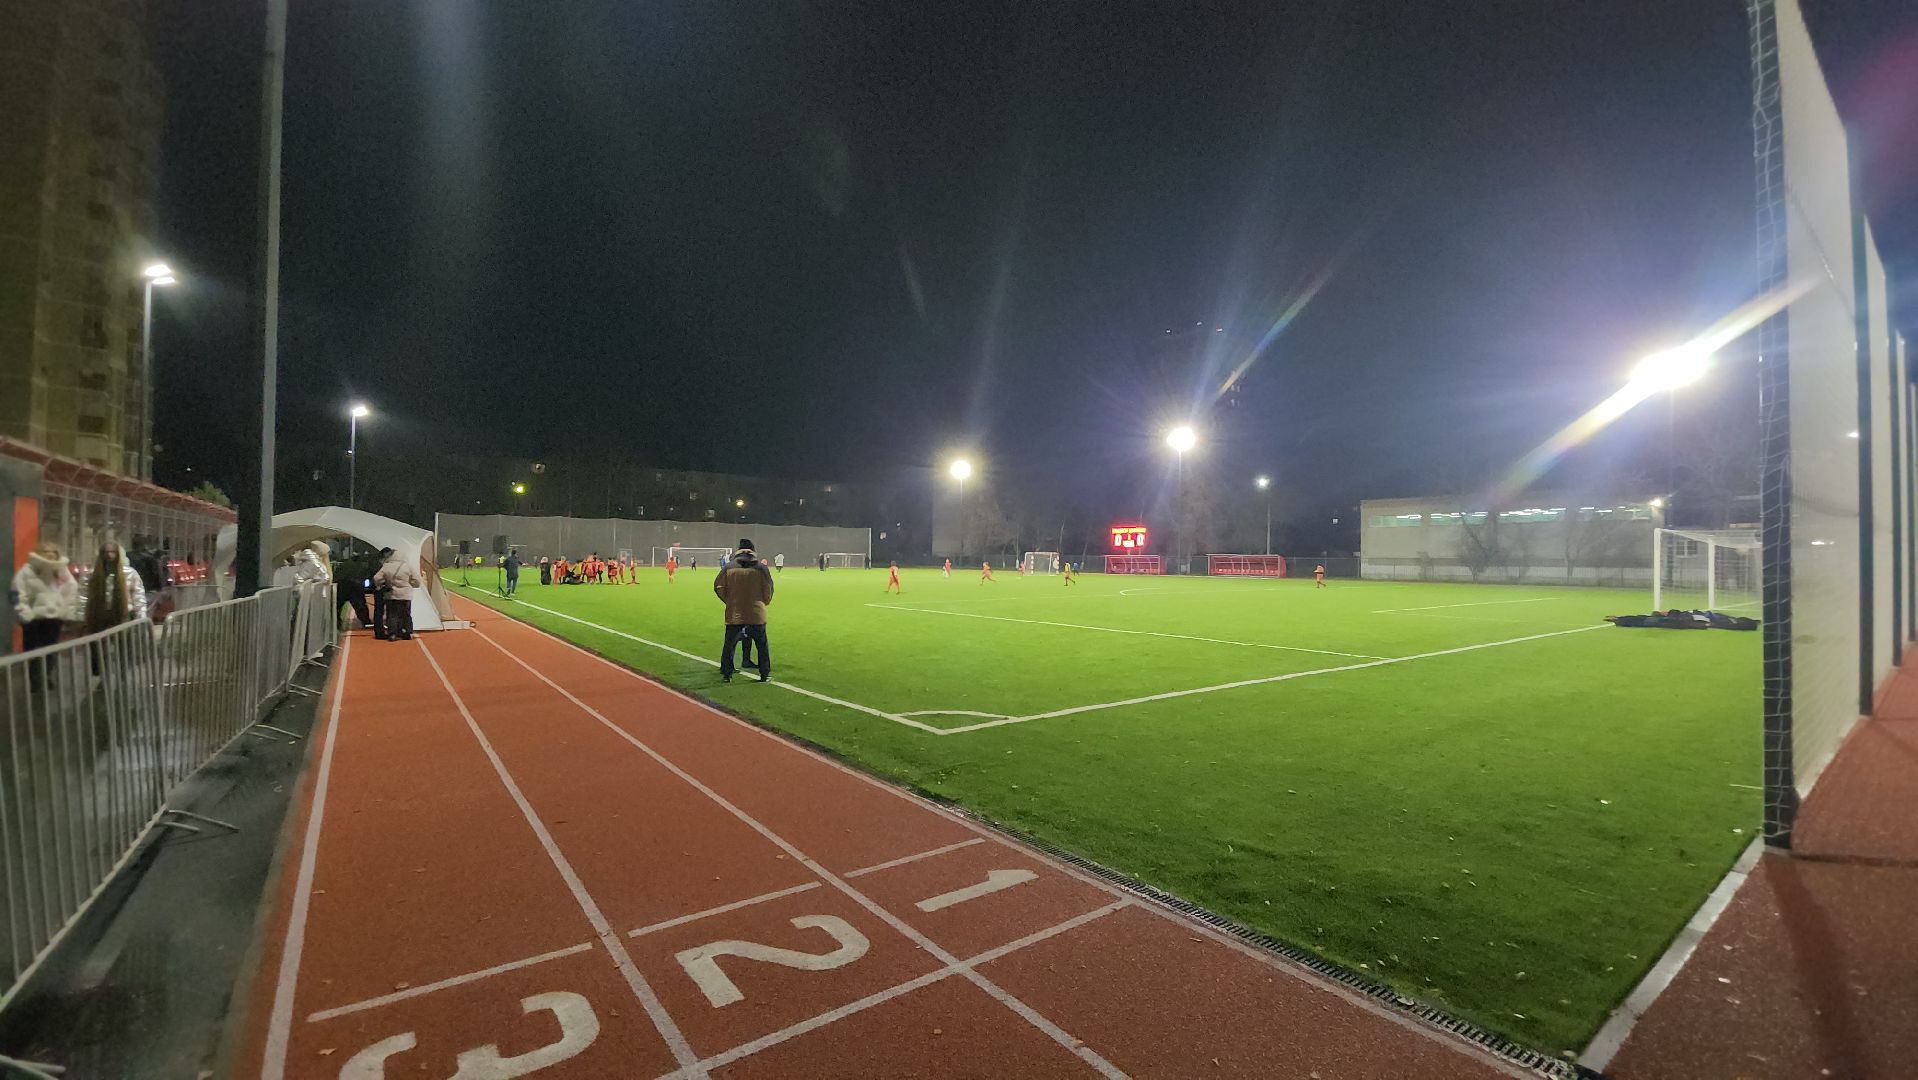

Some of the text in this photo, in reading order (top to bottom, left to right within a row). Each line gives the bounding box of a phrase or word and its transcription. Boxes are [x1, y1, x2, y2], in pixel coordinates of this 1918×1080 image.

[914, 868, 1039, 913] 1
[674, 914, 871, 1009] 2
[338, 990, 601, 1080] 3
